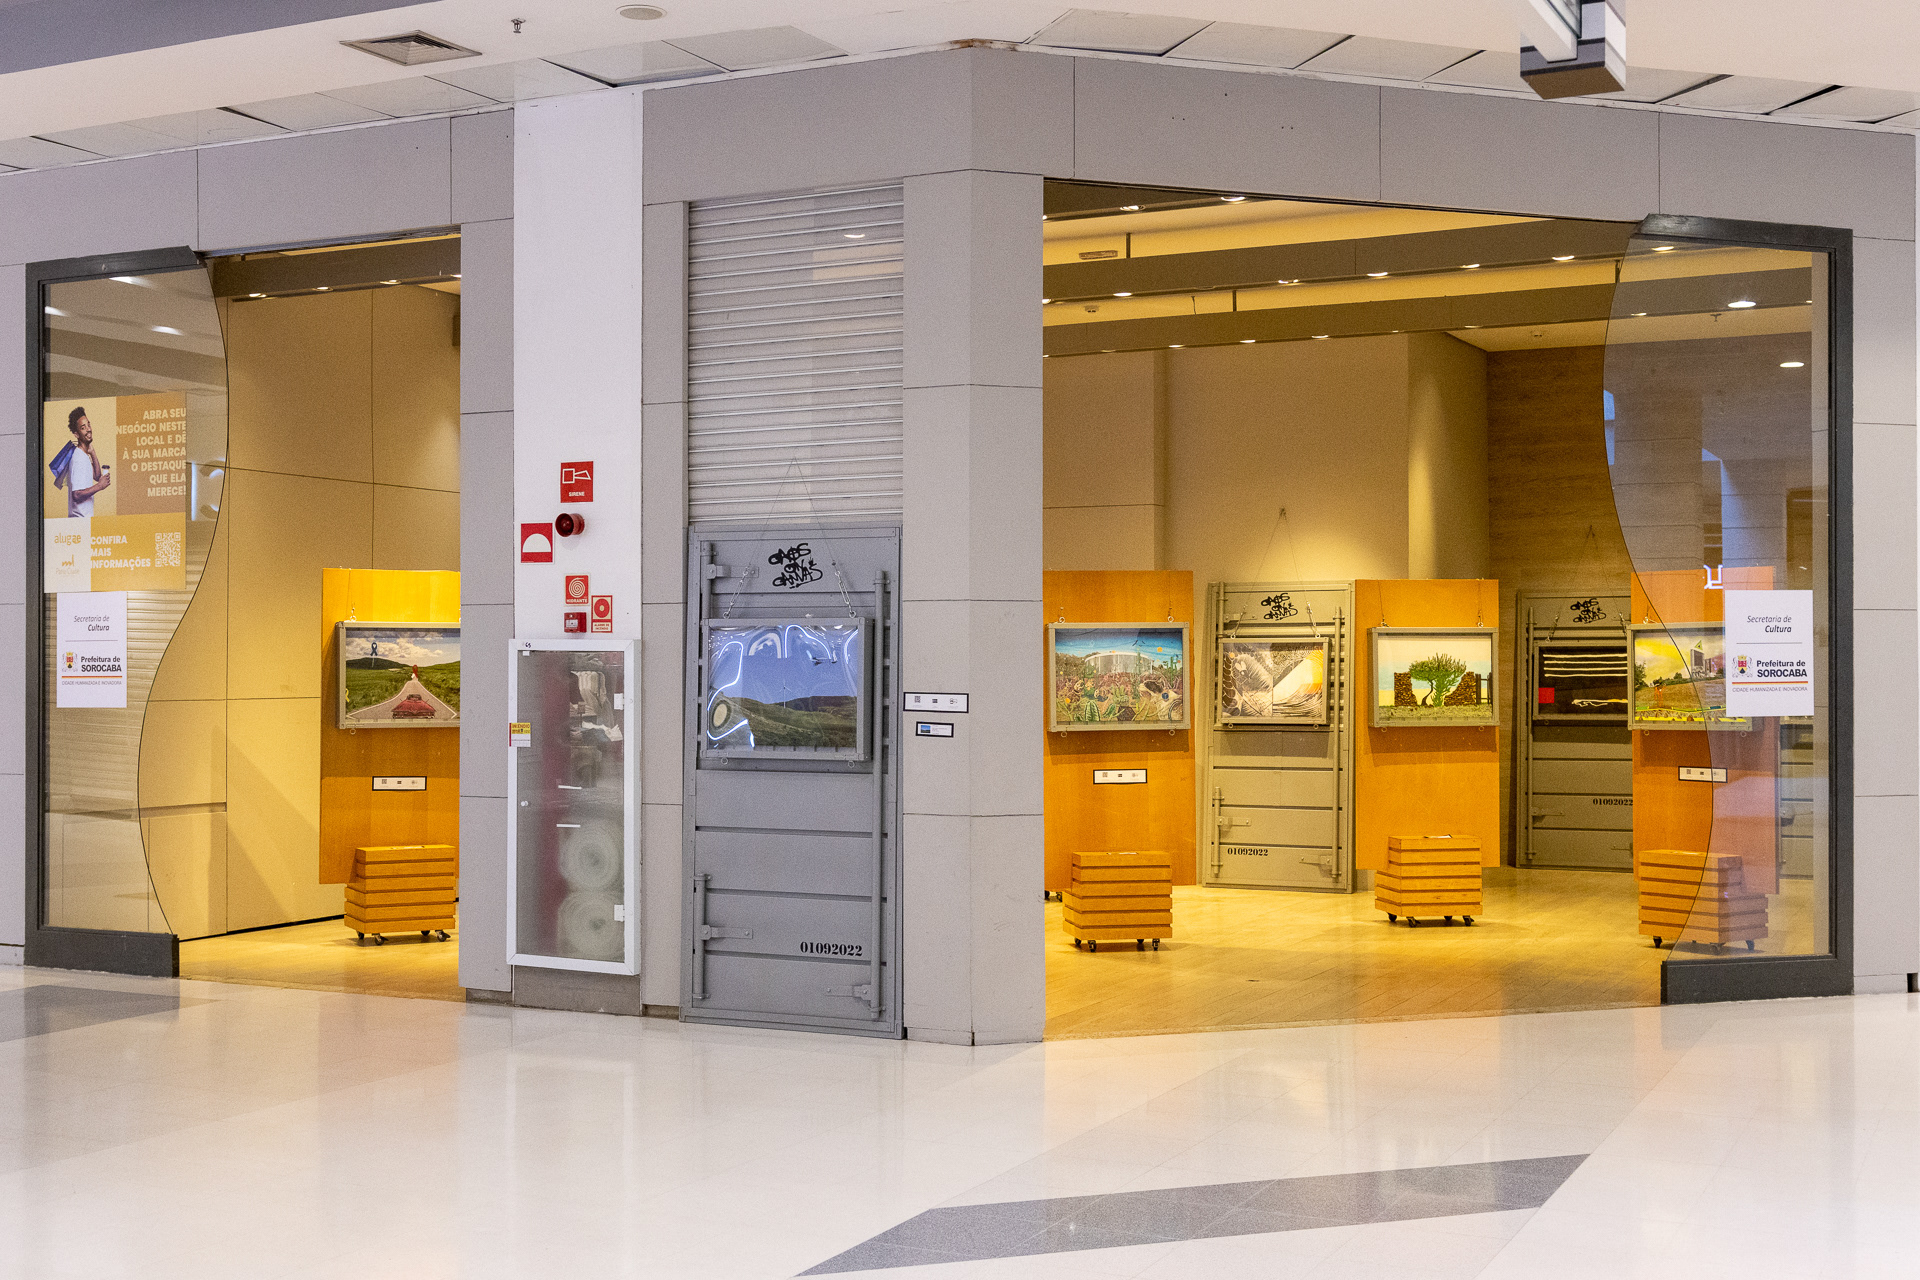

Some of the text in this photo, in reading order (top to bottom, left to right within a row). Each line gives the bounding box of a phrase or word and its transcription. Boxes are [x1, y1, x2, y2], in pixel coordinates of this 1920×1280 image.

[143, 408, 186, 420] ABRA SEU
[116, 420, 186, 434] NEGÓCIO NESTE
[136, 431, 186, 446] LOCAL E DÊ
[122, 446, 186, 460] À SUA MARCA
[131, 460, 186, 472] O DESTAQUE
[150, 472, 186, 485] QUE ELA
[148, 486, 186, 497] MERECE!
[90, 535, 128, 545] CONFIRA
[90, 548, 112, 557] MAIS
[90, 556, 151, 570] INFORMAÇÕES
[1747, 615, 1781, 623] Secretaria
[1765, 625, 1792, 633] Cultura
[1757, 669, 1807, 678] SOROCABA
[1592, 798, 1633, 806] 01092022
[1227, 848, 1268, 856] 01092022
[800, 941, 862, 956] 01092022
